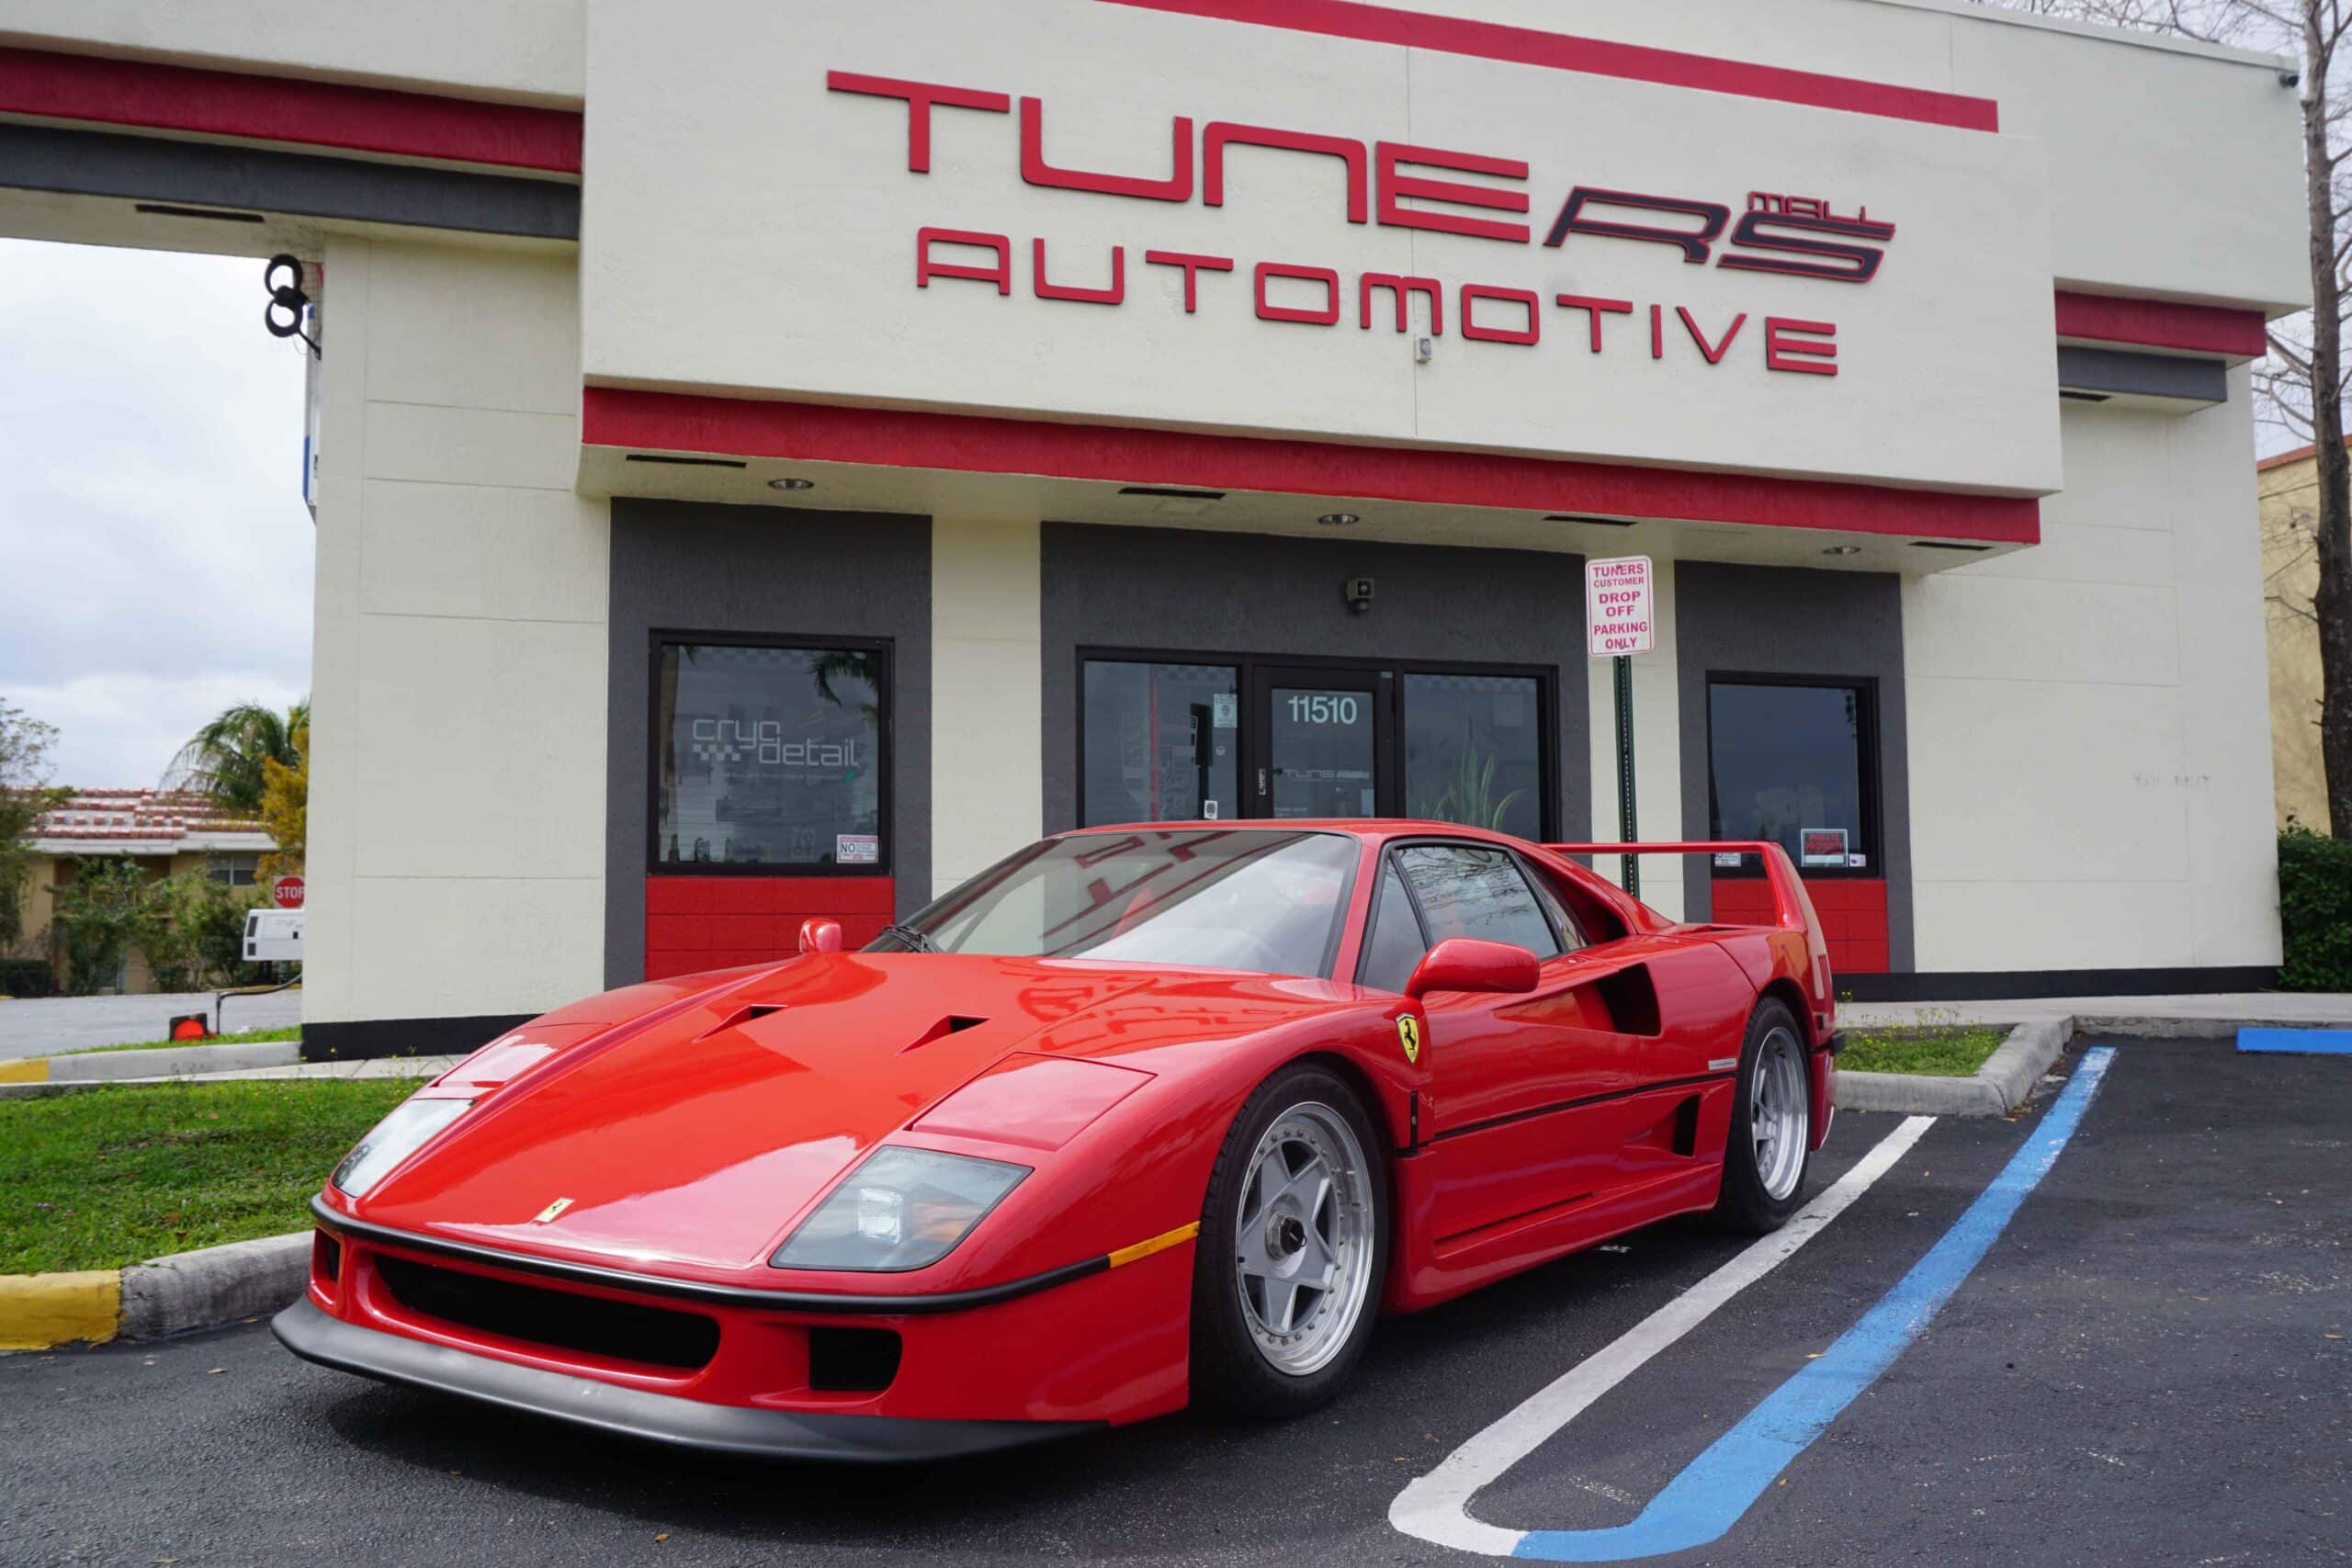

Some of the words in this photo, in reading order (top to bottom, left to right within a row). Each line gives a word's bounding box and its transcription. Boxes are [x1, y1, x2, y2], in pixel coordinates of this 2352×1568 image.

[1748, 191, 1895, 228] MALL
[917, 226, 1838, 376] AUTOMOTIVE
[1593, 563, 1644, 578] TUNERS
[1593, 576, 1645, 588] CUSTOMER
[1599, 591, 1641, 604] DROP
[1606, 604, 1634, 617] OFF
[1594, 621, 1647, 635] PARKING
[1605, 637, 1637, 649] ONLY
[1287, 695, 1357, 724] 11510
[693, 719, 781, 750] cryo
[759, 738, 859, 766] detail
[841, 843, 855, 852] NO
